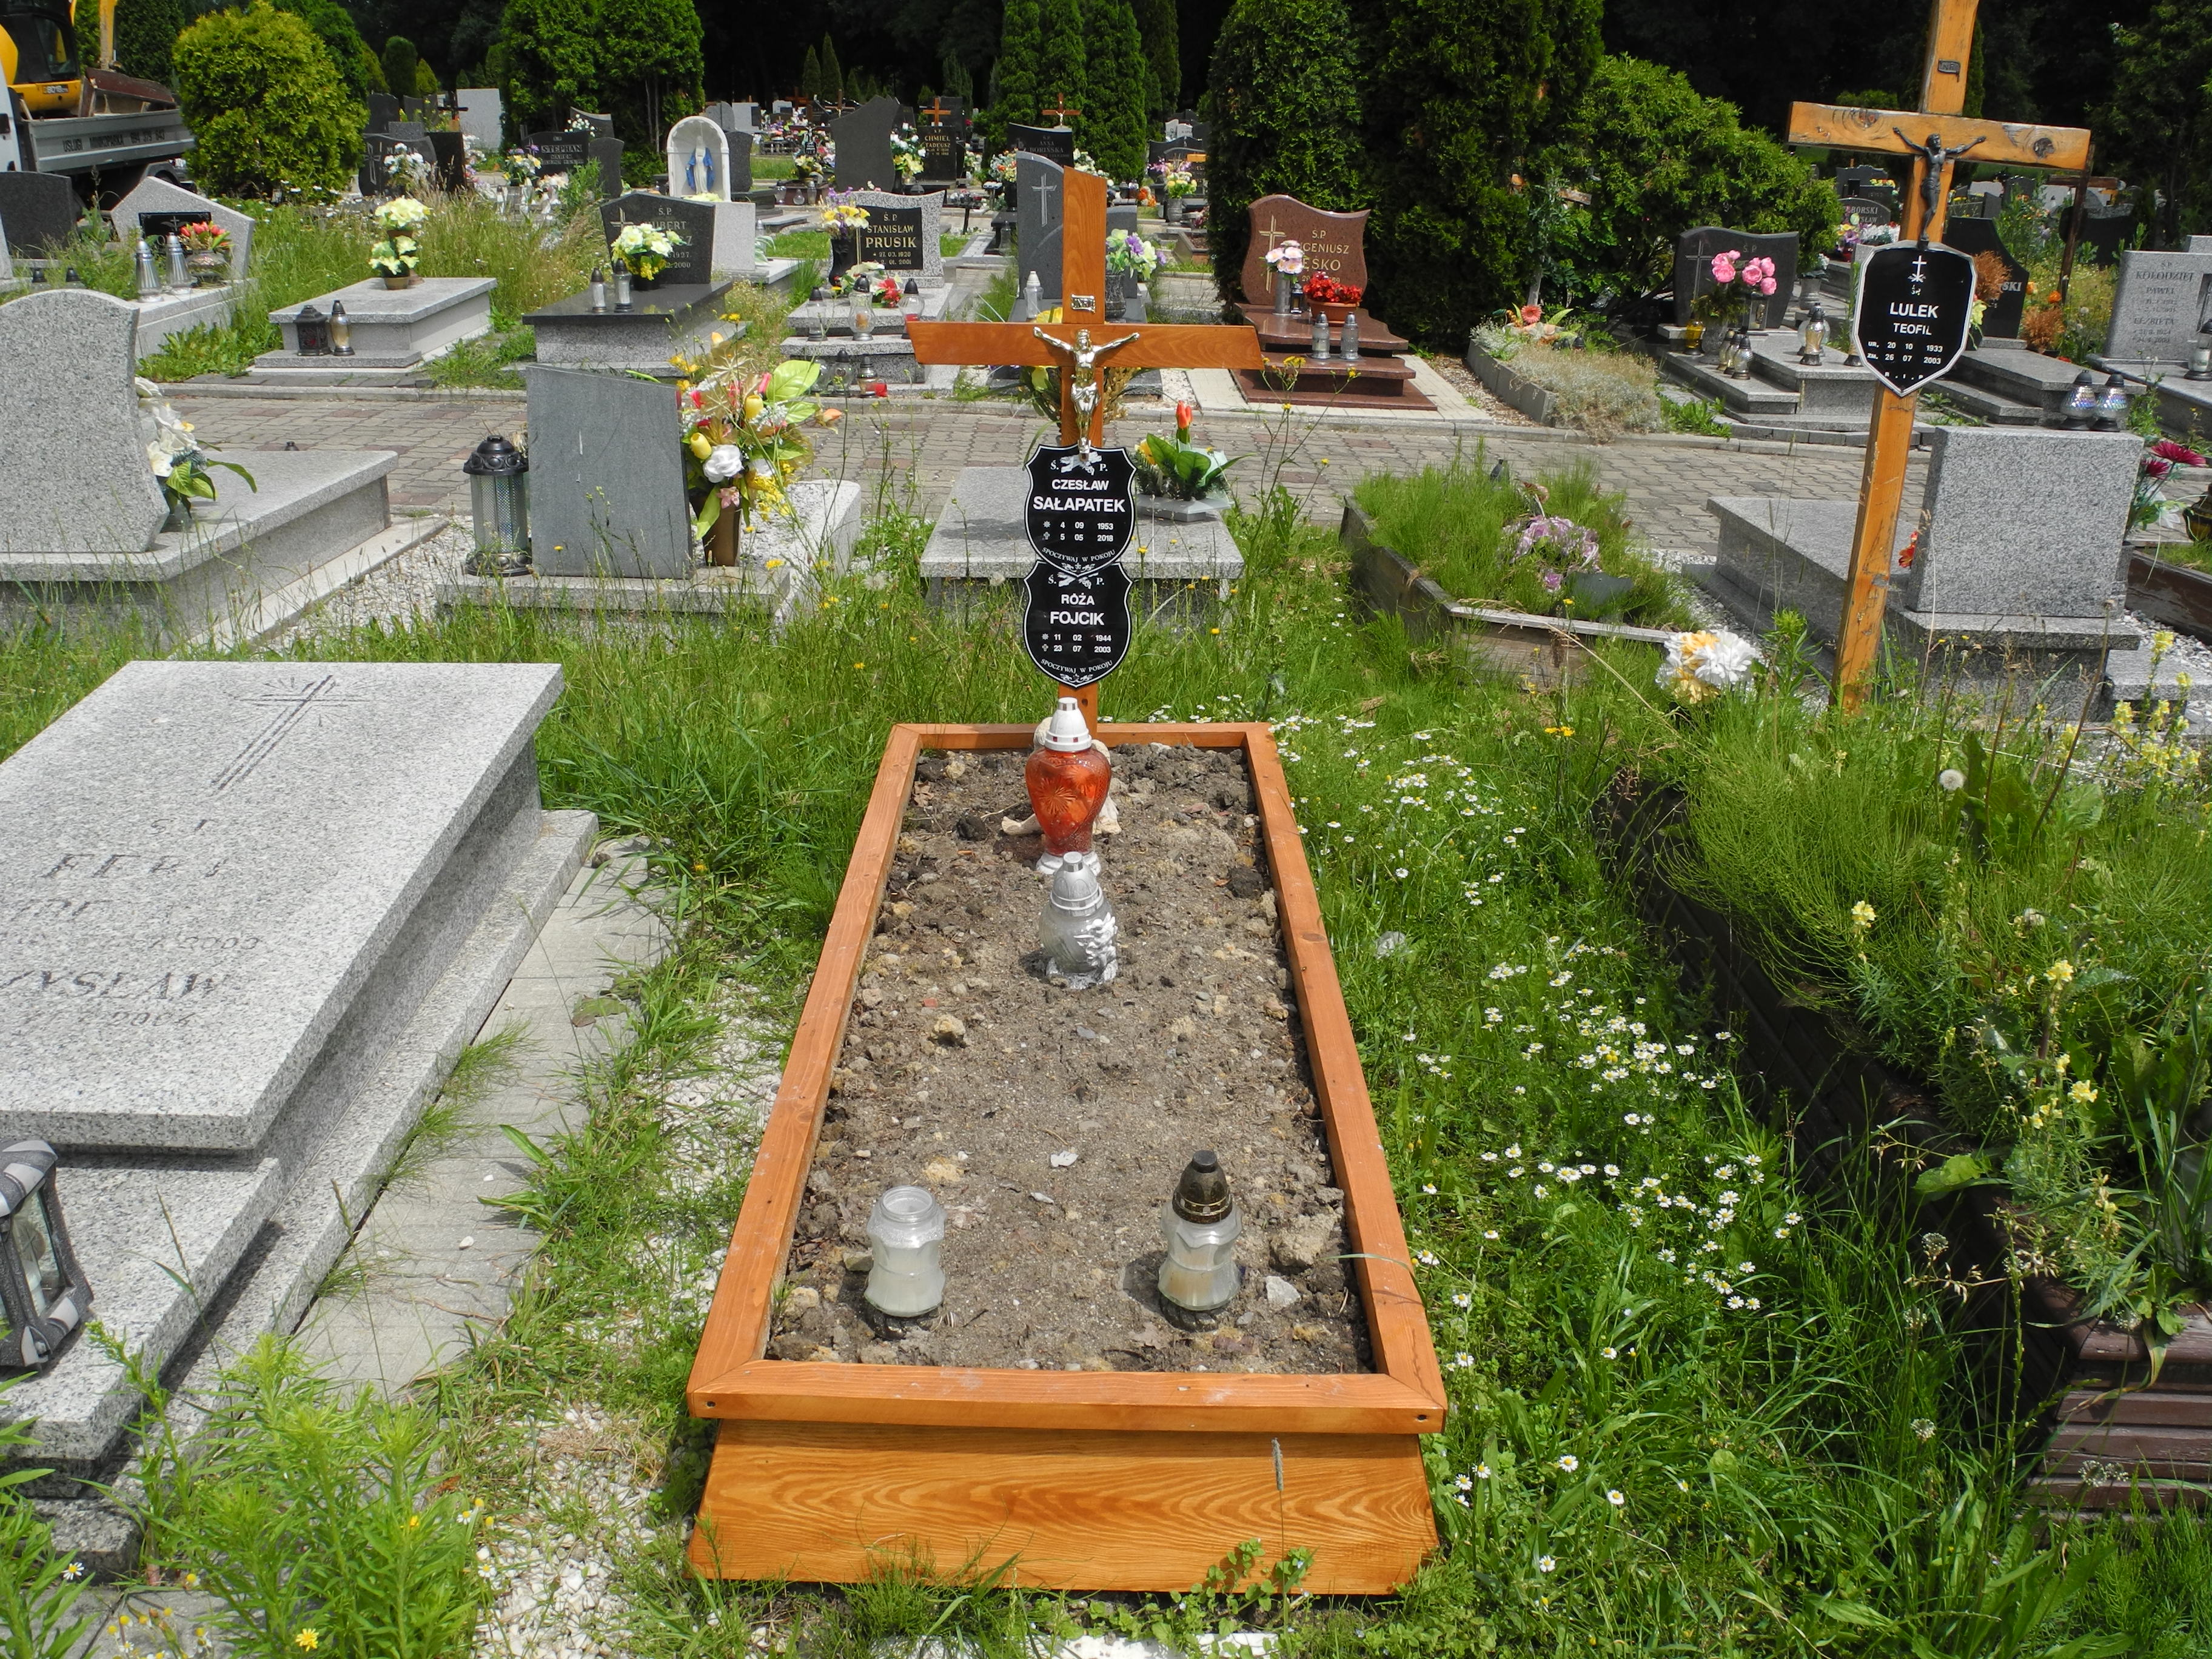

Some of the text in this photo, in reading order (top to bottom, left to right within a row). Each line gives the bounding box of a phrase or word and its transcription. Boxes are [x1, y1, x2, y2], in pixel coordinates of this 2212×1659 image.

[867, 225, 914, 233] STANISŁAW
[865, 236, 917, 248] PRUSIK
[1889, 302, 1939, 318] LULEK
[1893, 323, 1932, 335] TEOFIL
[1099, 463, 1108, 472] P.
[1052, 479, 1109, 491] CZESŁAW
[1033, 496, 1125, 512] SAŁAPATEK
[1042, 548, 1078, 563] SPOCZYWAJ
[1091, 549, 1116, 561] POKOJU
[1061, 592, 1094, 605] RÓŻA
[1050, 611, 1105, 625] FOJCIK
[1041, 659, 1076, 674] SPOCZYWAJ
[1088, 660, 1113, 672] POKOJU
